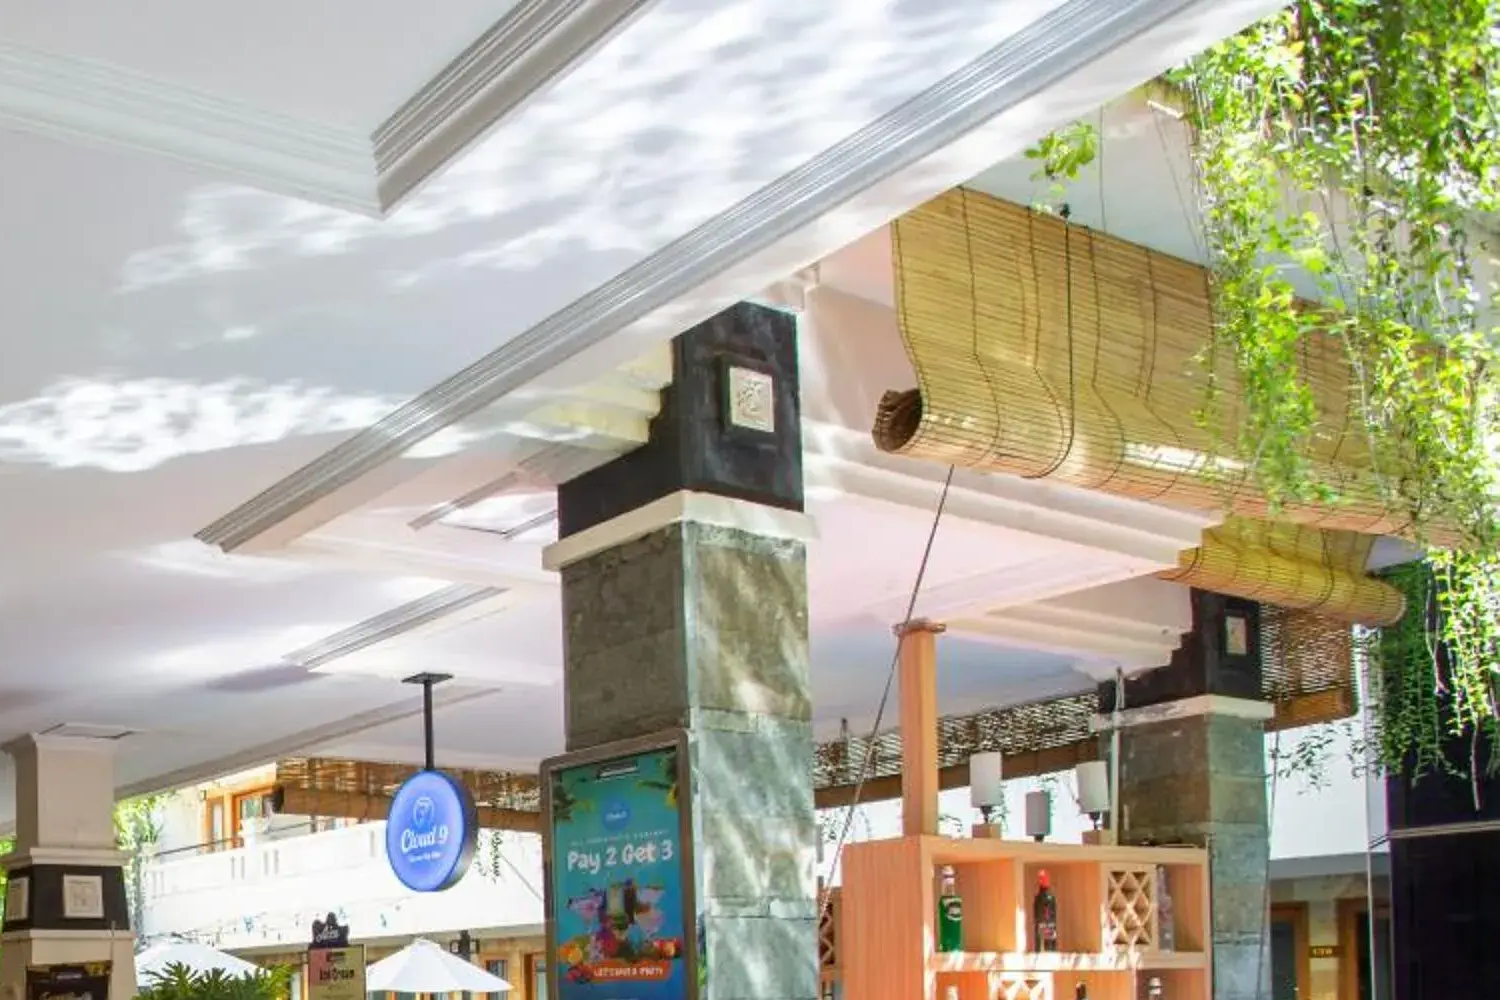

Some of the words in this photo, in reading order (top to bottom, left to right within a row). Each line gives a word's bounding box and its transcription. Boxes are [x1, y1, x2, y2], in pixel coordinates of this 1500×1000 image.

[401, 824, 437, 853] Cloud
[439, 824, 449, 844] 9
[567, 850, 601, 875] Pay
[605, 845, 617, 866] 2
[622, 839, 658, 865] Get
[661, 839, 673, 860] 3
